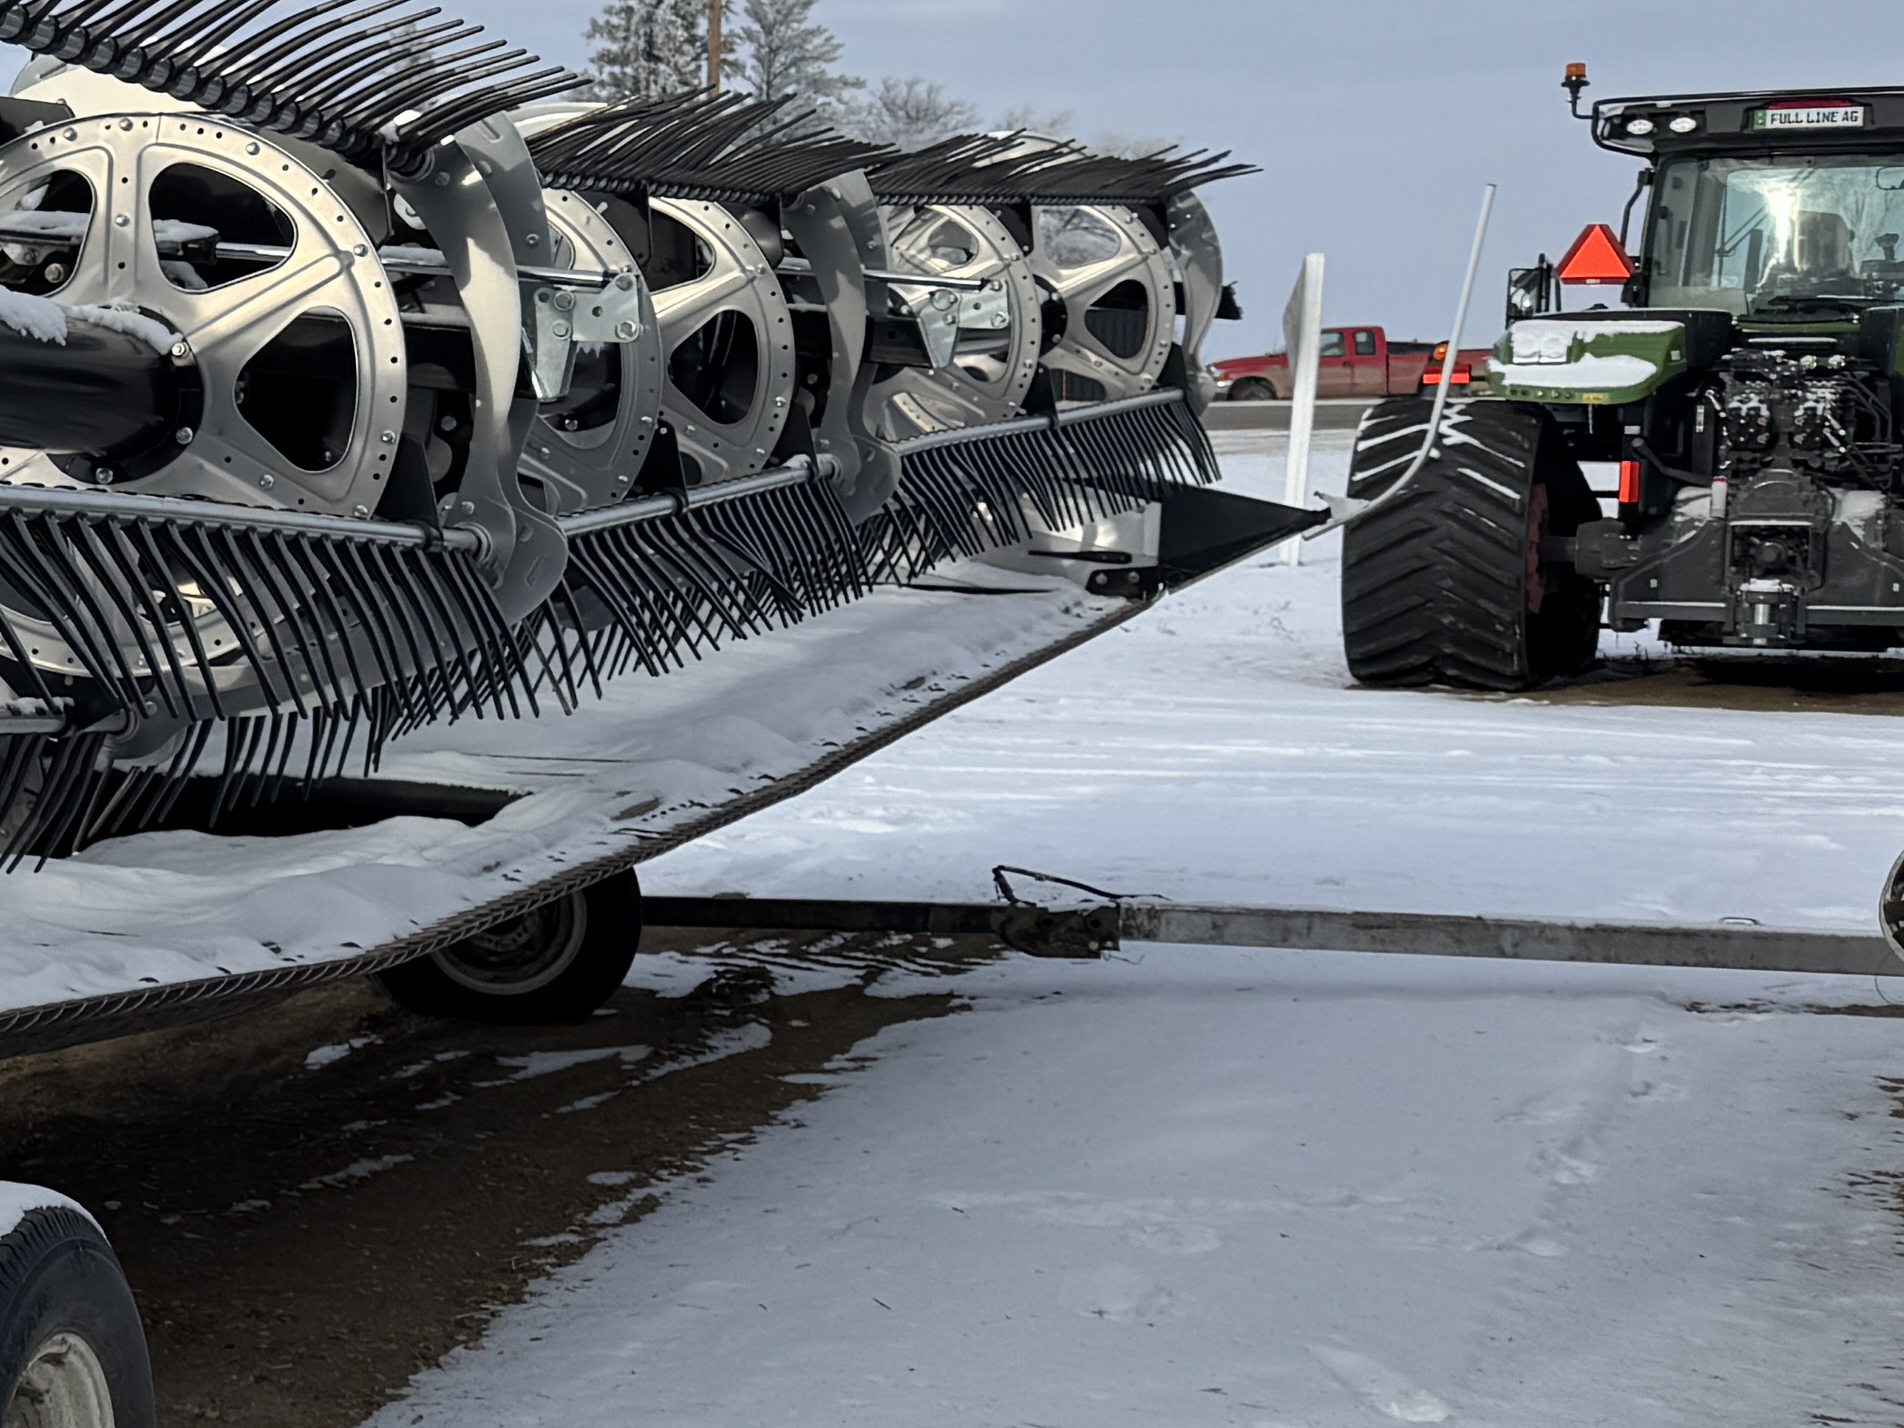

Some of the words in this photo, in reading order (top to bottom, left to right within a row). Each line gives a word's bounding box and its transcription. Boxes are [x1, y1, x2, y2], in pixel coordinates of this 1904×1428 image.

[1770, 112, 1803, 125] FULL
[1806, 111, 1839, 124] LINE
[1841, 110, 1859, 122] AG
